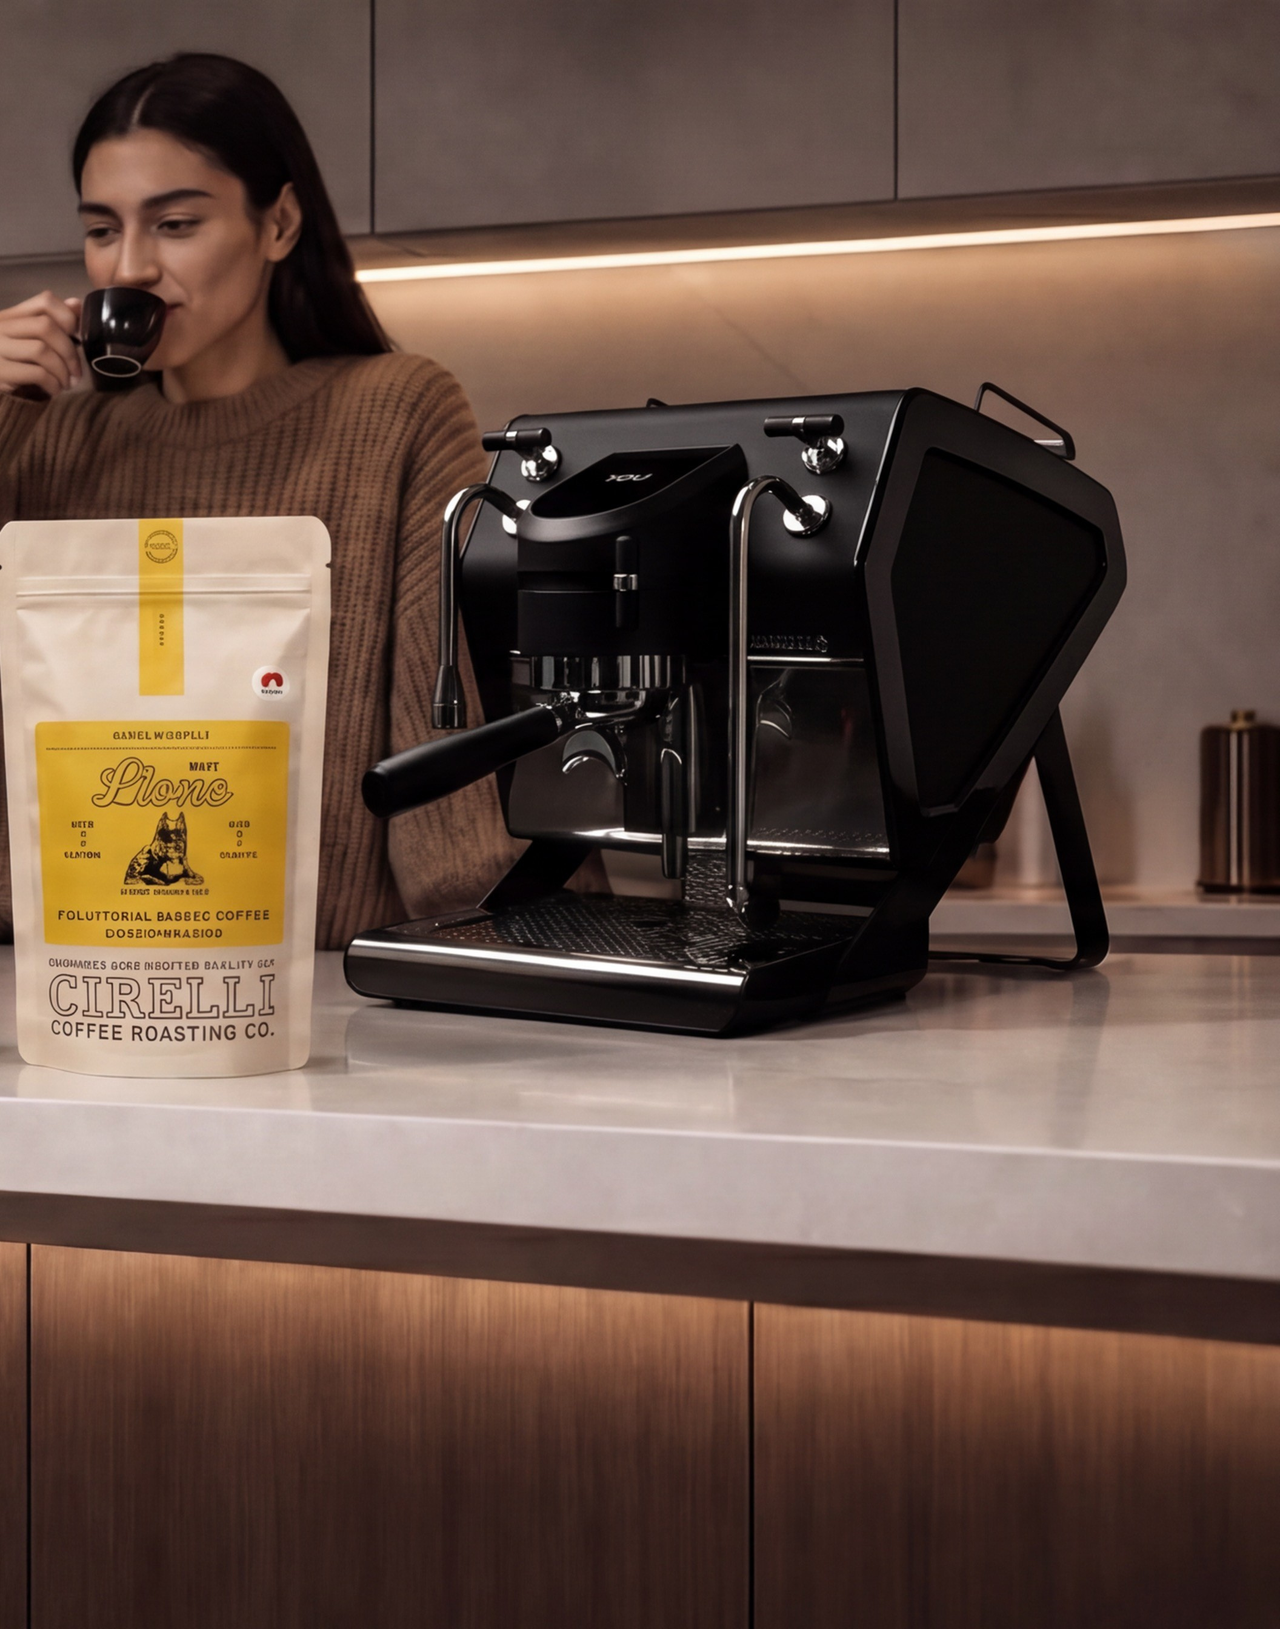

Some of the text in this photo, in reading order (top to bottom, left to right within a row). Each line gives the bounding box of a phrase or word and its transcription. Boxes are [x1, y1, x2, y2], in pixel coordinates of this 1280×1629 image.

[216, 910, 270, 921] COFFEE
[48, 973, 276, 1019] CIRELLI
[51, 1019, 275, 1042] COFFEE ROASTING CO.
